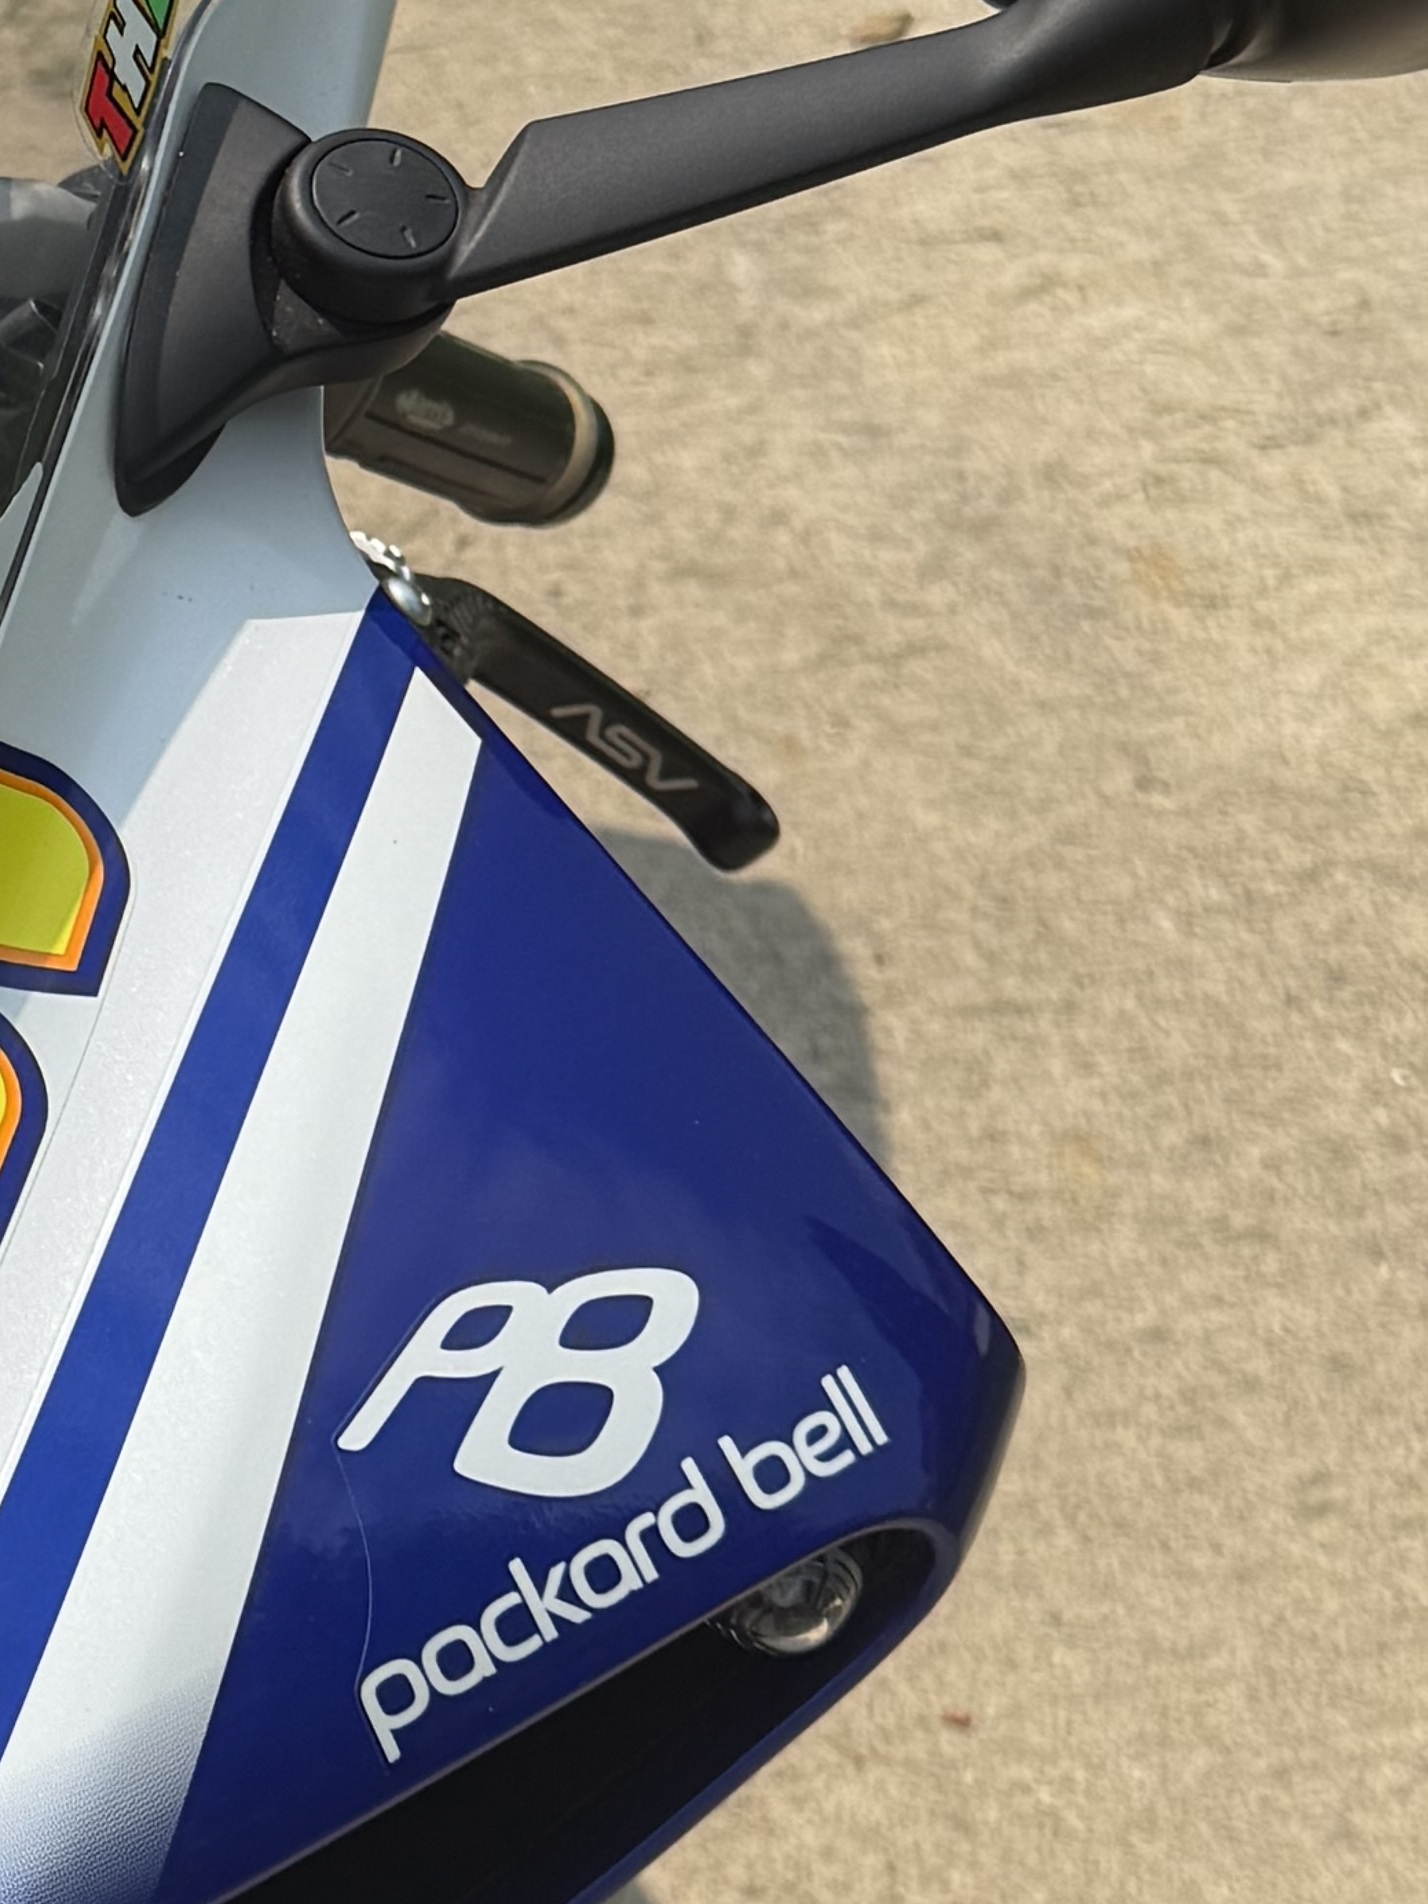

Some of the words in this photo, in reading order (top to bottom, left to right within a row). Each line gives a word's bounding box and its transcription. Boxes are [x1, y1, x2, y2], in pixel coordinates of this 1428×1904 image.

[548, 703, 700, 792] ASV
[358, 1455, 727, 1763] packard
[719, 1363, 890, 1514] bell
